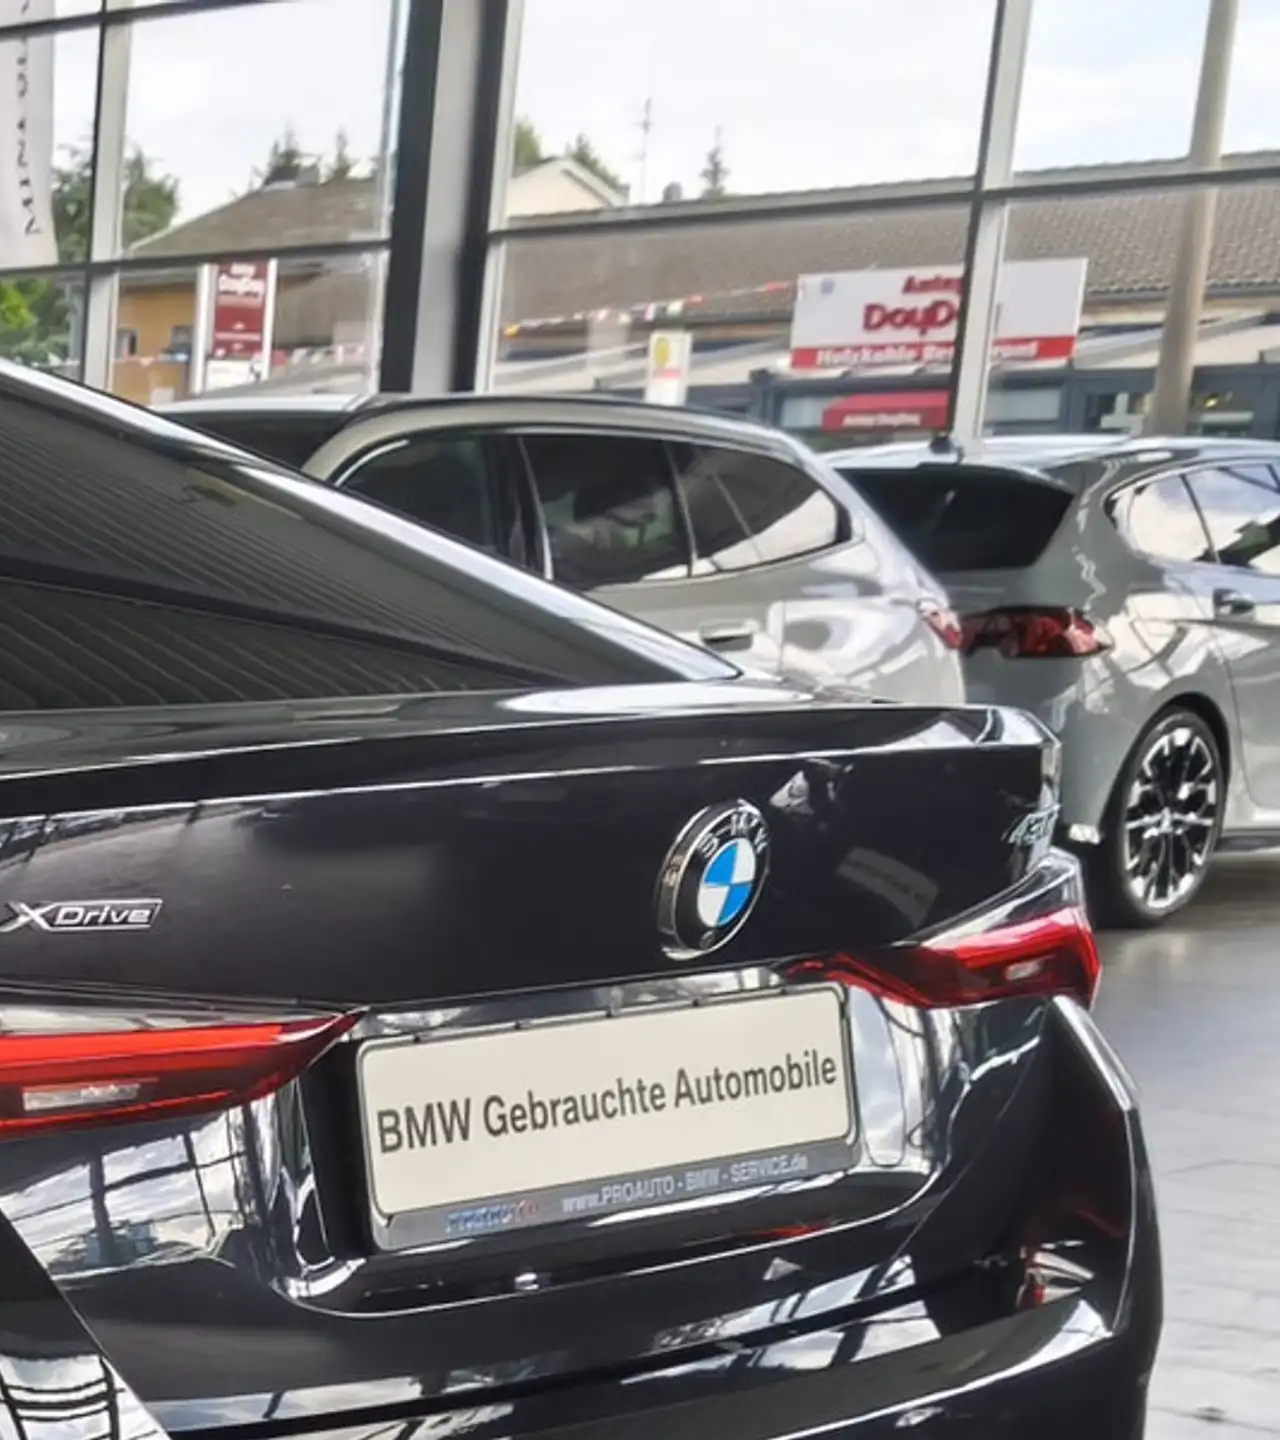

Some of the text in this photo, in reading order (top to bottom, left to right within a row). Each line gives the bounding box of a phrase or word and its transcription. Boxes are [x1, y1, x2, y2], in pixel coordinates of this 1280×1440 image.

[696, 810, 769, 859] BMW
[376, 1048, 838, 1155] BMW Gebrauchte Automobile
